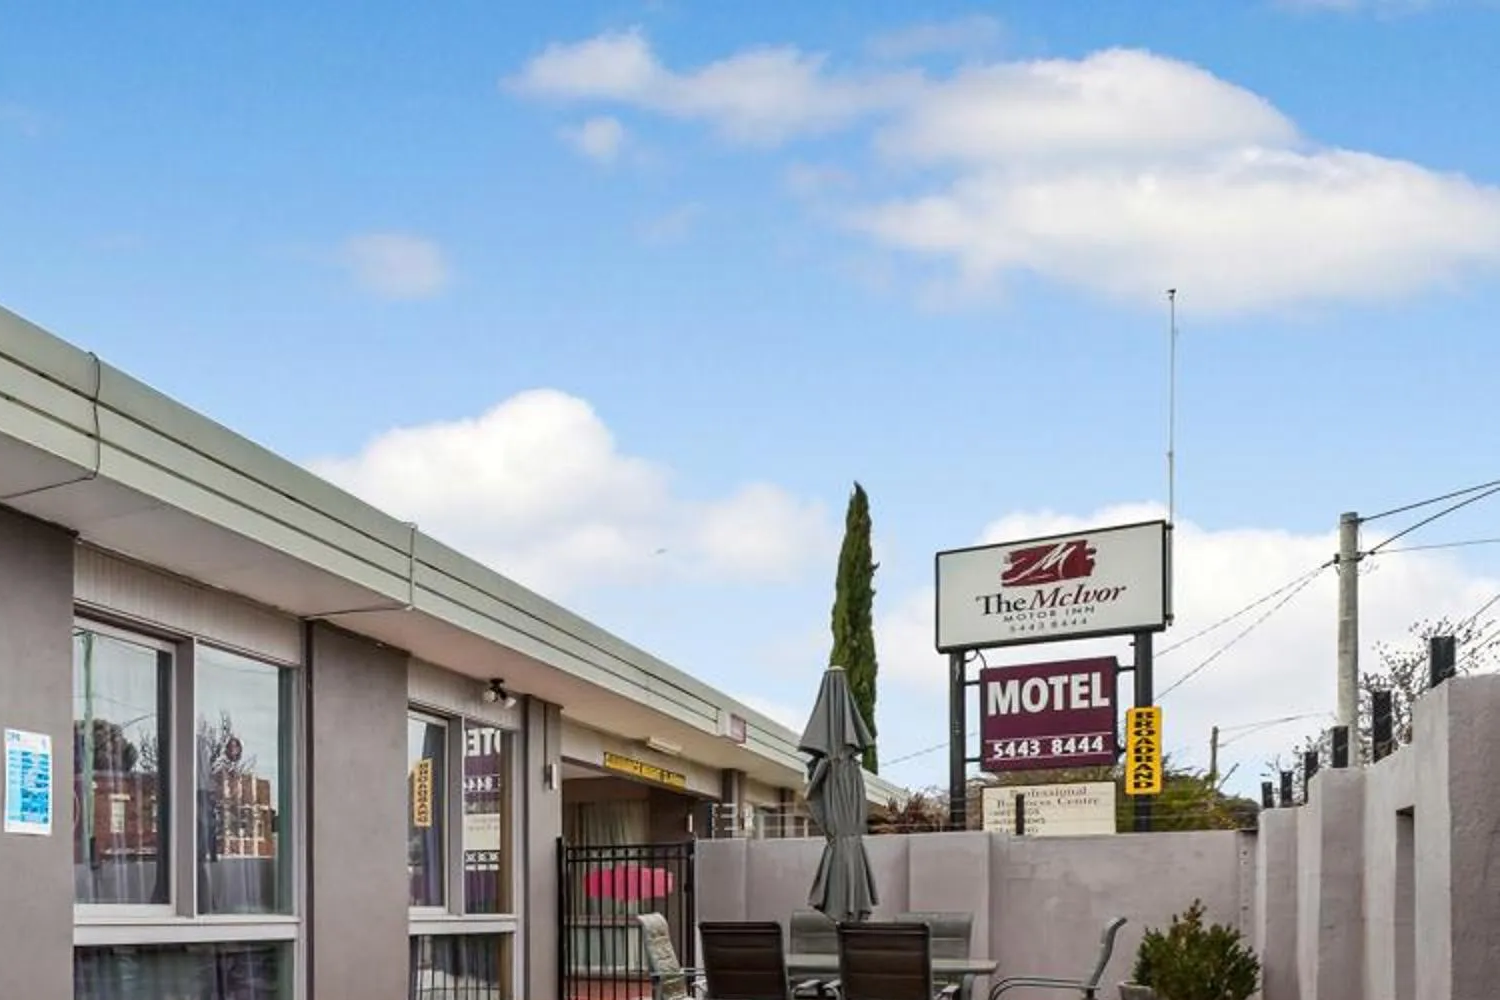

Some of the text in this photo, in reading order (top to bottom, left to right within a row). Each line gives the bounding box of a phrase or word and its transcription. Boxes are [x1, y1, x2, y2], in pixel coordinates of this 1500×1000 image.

[975, 583, 1127, 615] The McIvor
[1003, 605, 1095, 622] MOTOR INN
[987, 672, 1110, 716] MOTEL
[993, 735, 1104, 759] 5443 8444
[1134, 711, 1156, 789] BROADBAND
